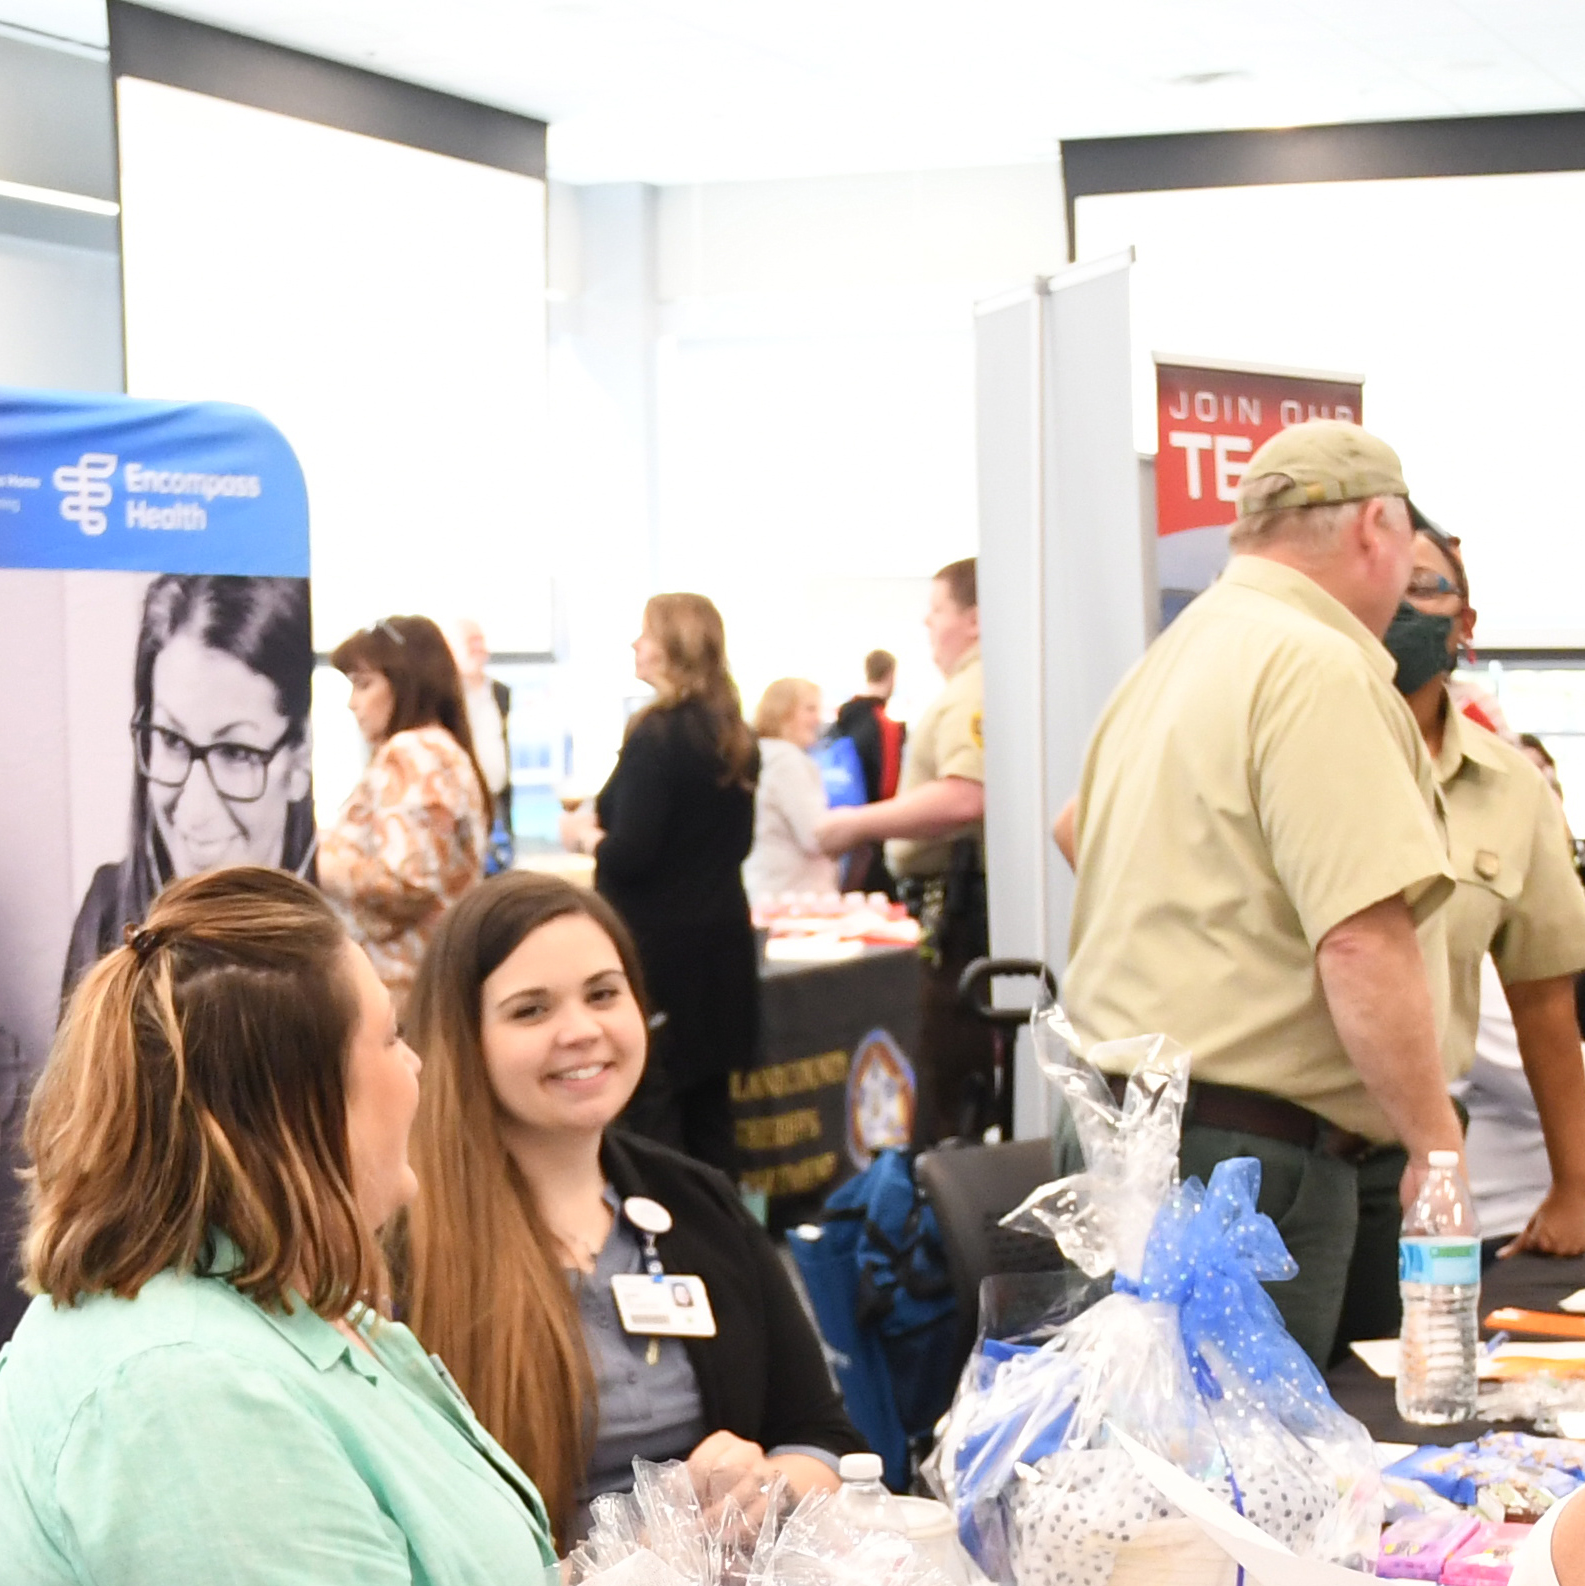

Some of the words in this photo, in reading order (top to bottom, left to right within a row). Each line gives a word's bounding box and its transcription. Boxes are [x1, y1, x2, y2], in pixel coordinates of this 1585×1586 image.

[1169, 391, 1262, 426] JOIN
[125, 462, 261, 501] Encompass
[126, 500, 208, 531] Health
